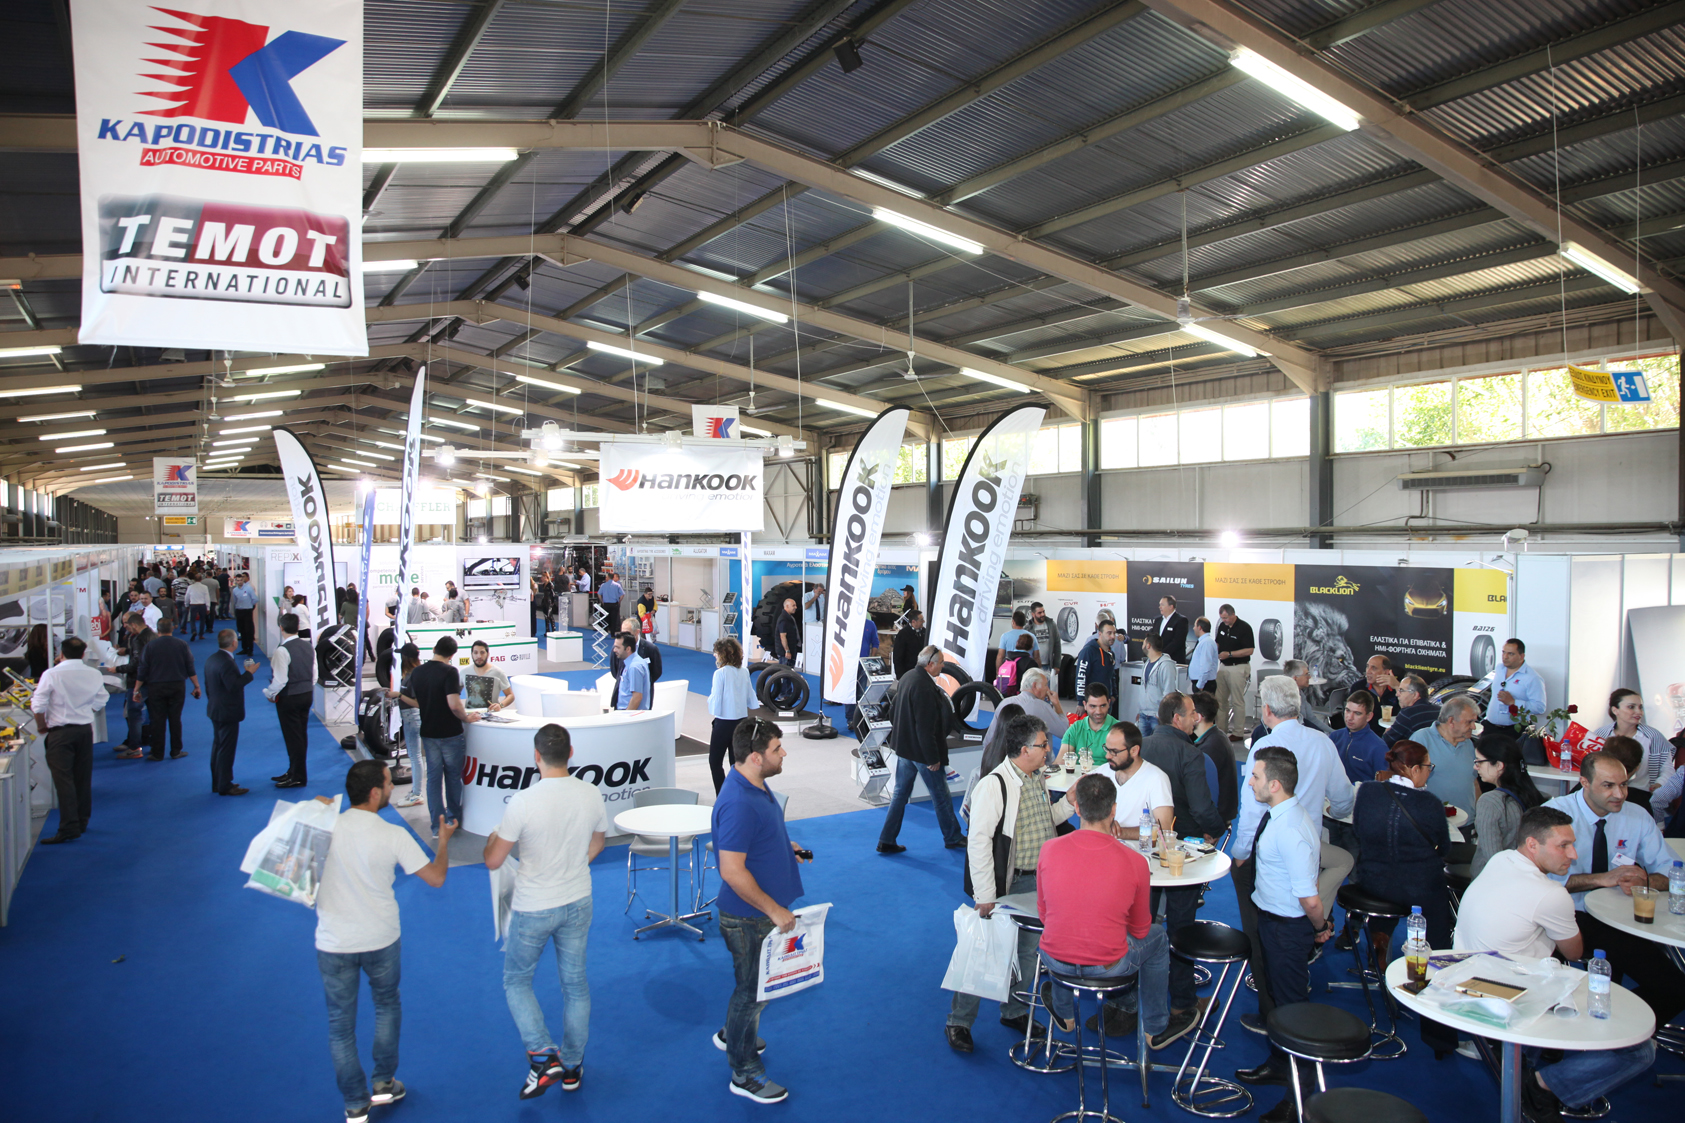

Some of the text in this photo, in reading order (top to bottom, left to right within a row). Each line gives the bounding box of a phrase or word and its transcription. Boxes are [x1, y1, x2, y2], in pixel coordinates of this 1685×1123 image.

[97, 118, 347, 167] KAPODISTRIAS
[142, 149, 301, 178] AUTOMOTIVE PARTS
[117, 214, 337, 268] TEMOT
[109, 265, 343, 299] INTERNATIONAL
[1573, 382, 1616, 398] EMERGENCY EXIT
[159, 494, 193, 502] TEMOT
[977, 461, 1022, 624] driving emotion
[1262, 578, 1286, 586] ΣΤΡΟΦΗ
[1309, 586, 1354, 595] BLACKLION
[1370, 635, 1398, 644] ΕΛΑΣΤΙΚΑ
[1410, 639, 1440, 648] ΕΠΙΒΑΤΙΚΑ
[1441, 641, 1447, 649] &
[490, 655, 506, 663] FAG
[1374, 645, 1447, 658] ΗΜΙ-ΦΟΡΤΗΓΑ ΟΧΗΜΑΤΑ
[1076, 660, 1088, 697] ATHLETIC
